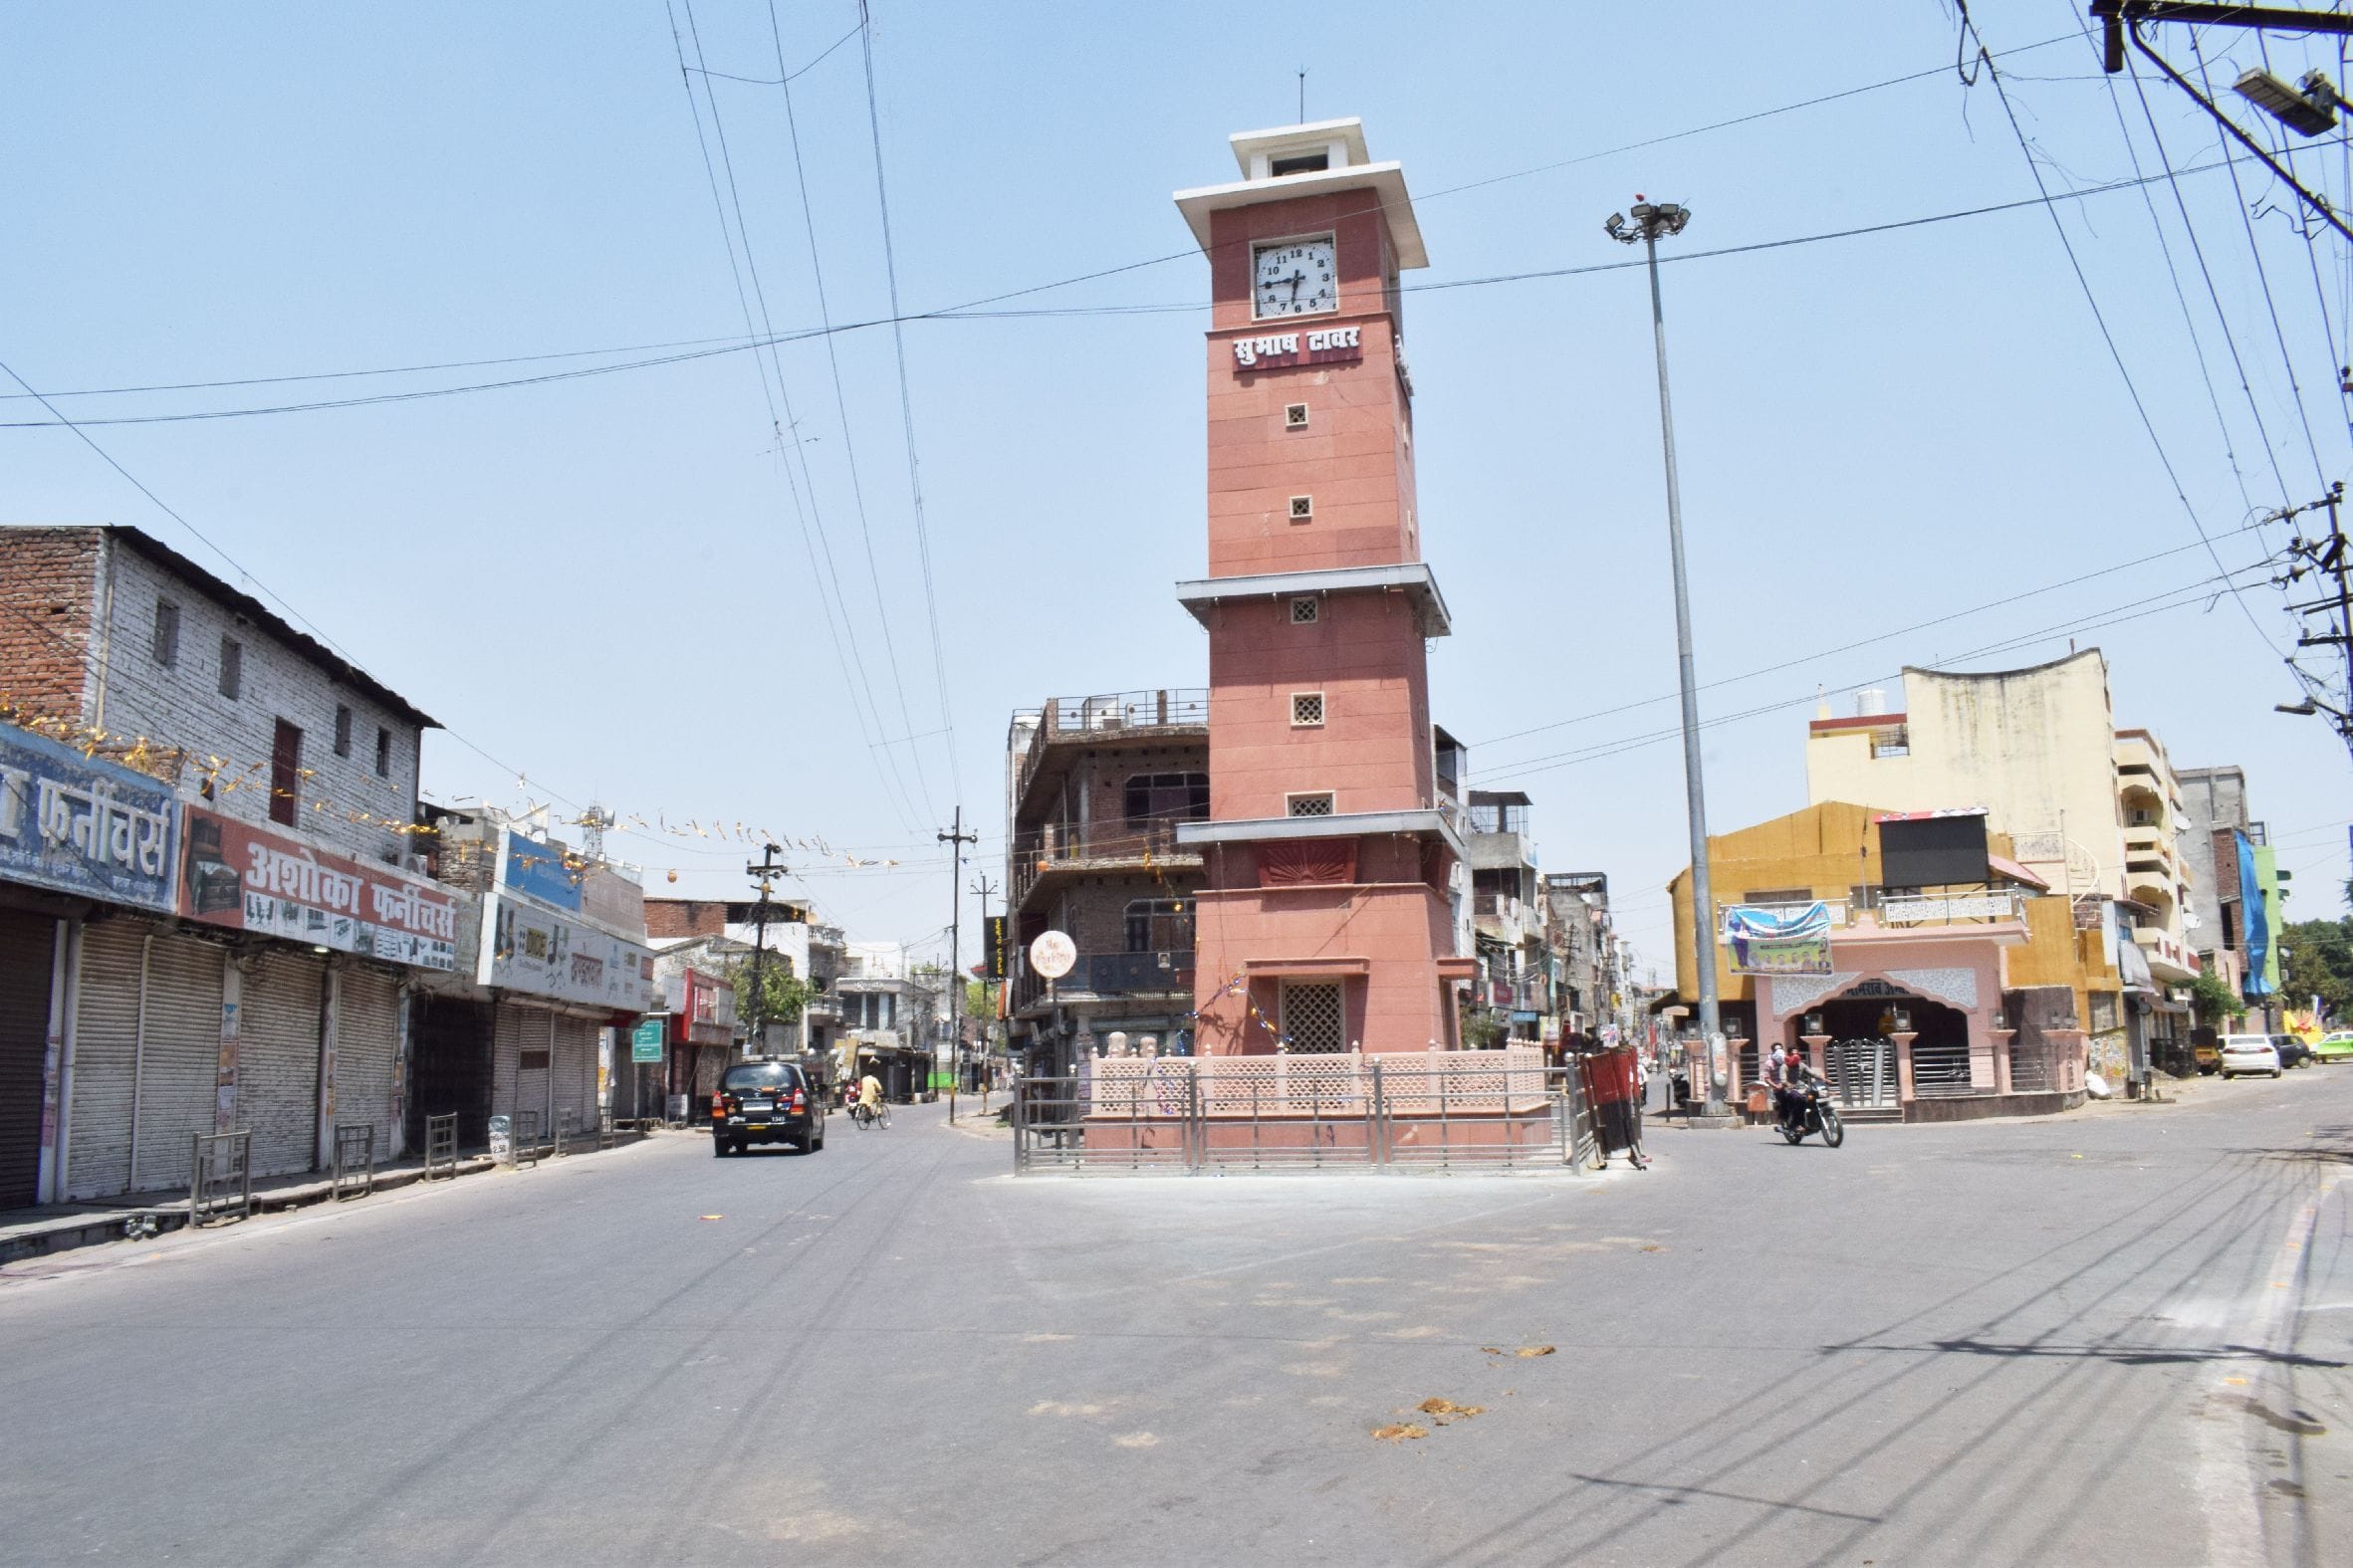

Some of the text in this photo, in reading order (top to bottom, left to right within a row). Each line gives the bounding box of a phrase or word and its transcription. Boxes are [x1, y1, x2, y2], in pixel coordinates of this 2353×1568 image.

[1291, 249, 1302, 259] 12
[1307, 251, 1313, 260] 1
[1277, 255, 1288, 264] 11
[1316, 259, 1324, 268] 2
[1268, 266, 1280, 276] 10
[1322, 273, 1329, 282] 3
[1318, 289, 1326, 298] 4
[1309, 299, 1316, 308] 5
[1233, 326, 1360, 365] सुभाष टावर
[245, 842, 363, 915] अशोका
